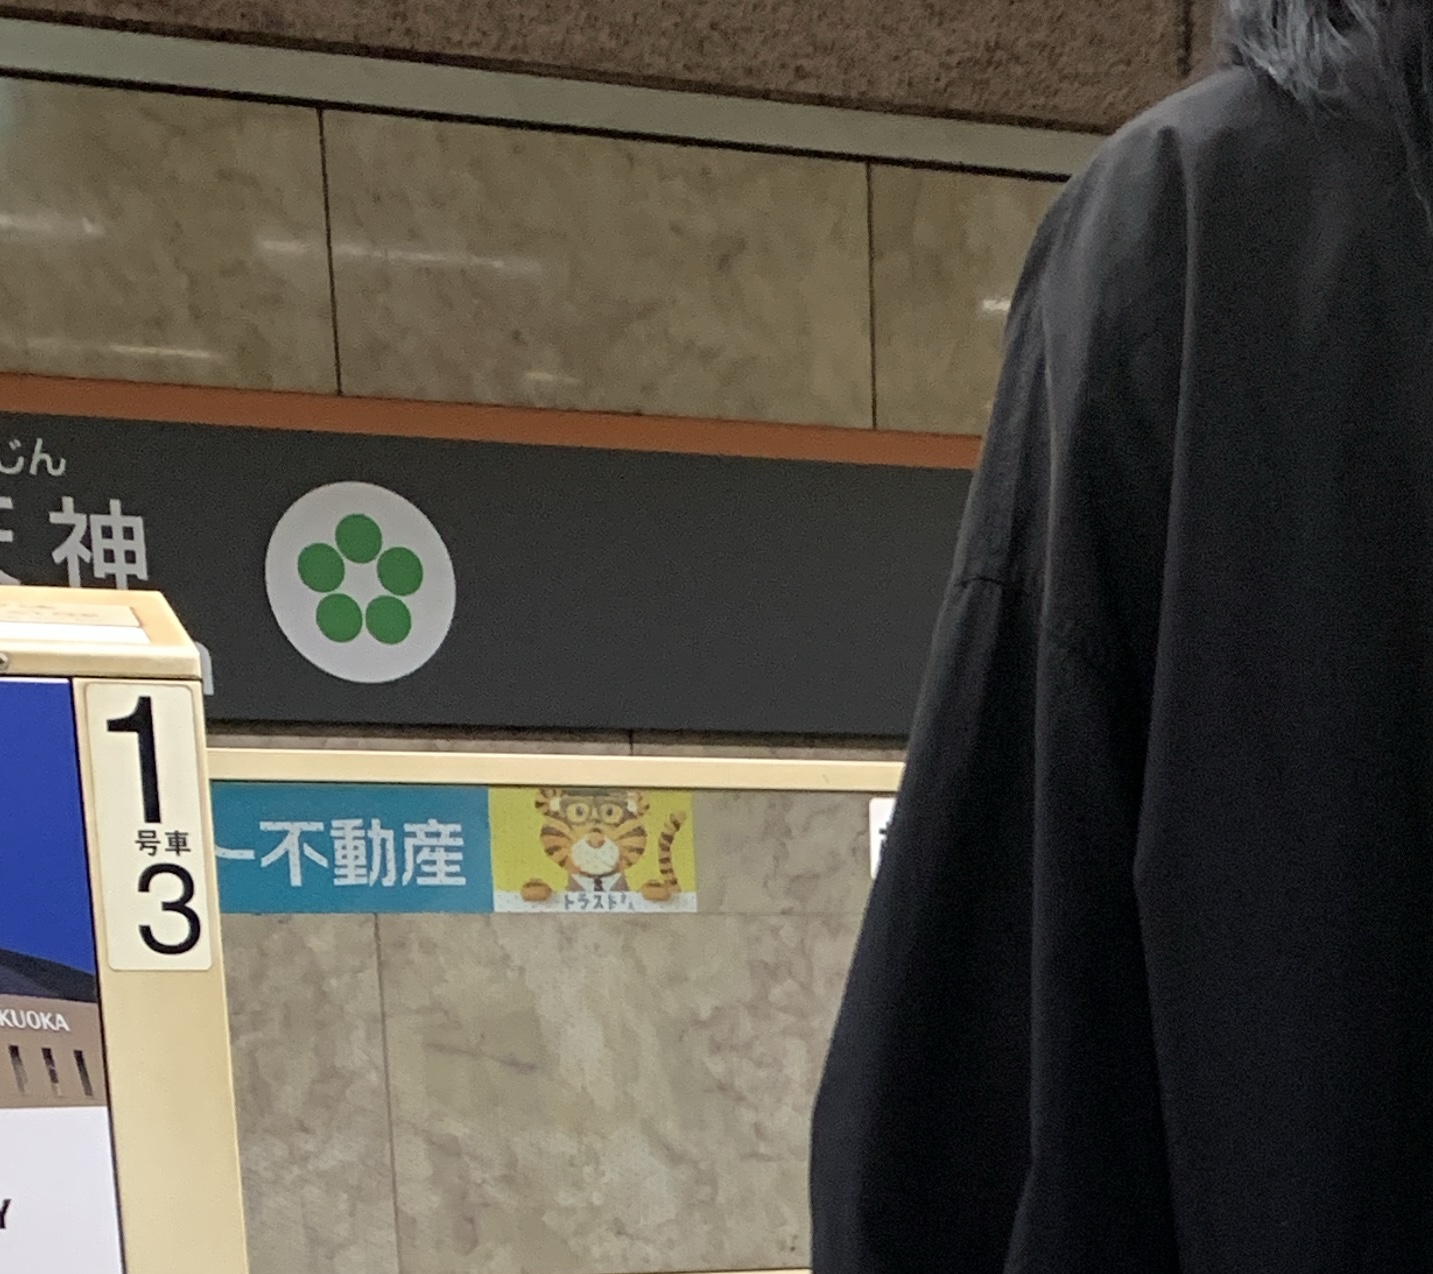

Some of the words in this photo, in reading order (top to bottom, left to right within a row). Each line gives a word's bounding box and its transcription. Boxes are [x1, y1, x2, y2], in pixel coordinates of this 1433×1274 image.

[0, 496, 148, 588] 神
[106, 695, 161, 823] 1
[135, 829, 191, 857] 号車
[138, 862, 201, 955] 3
